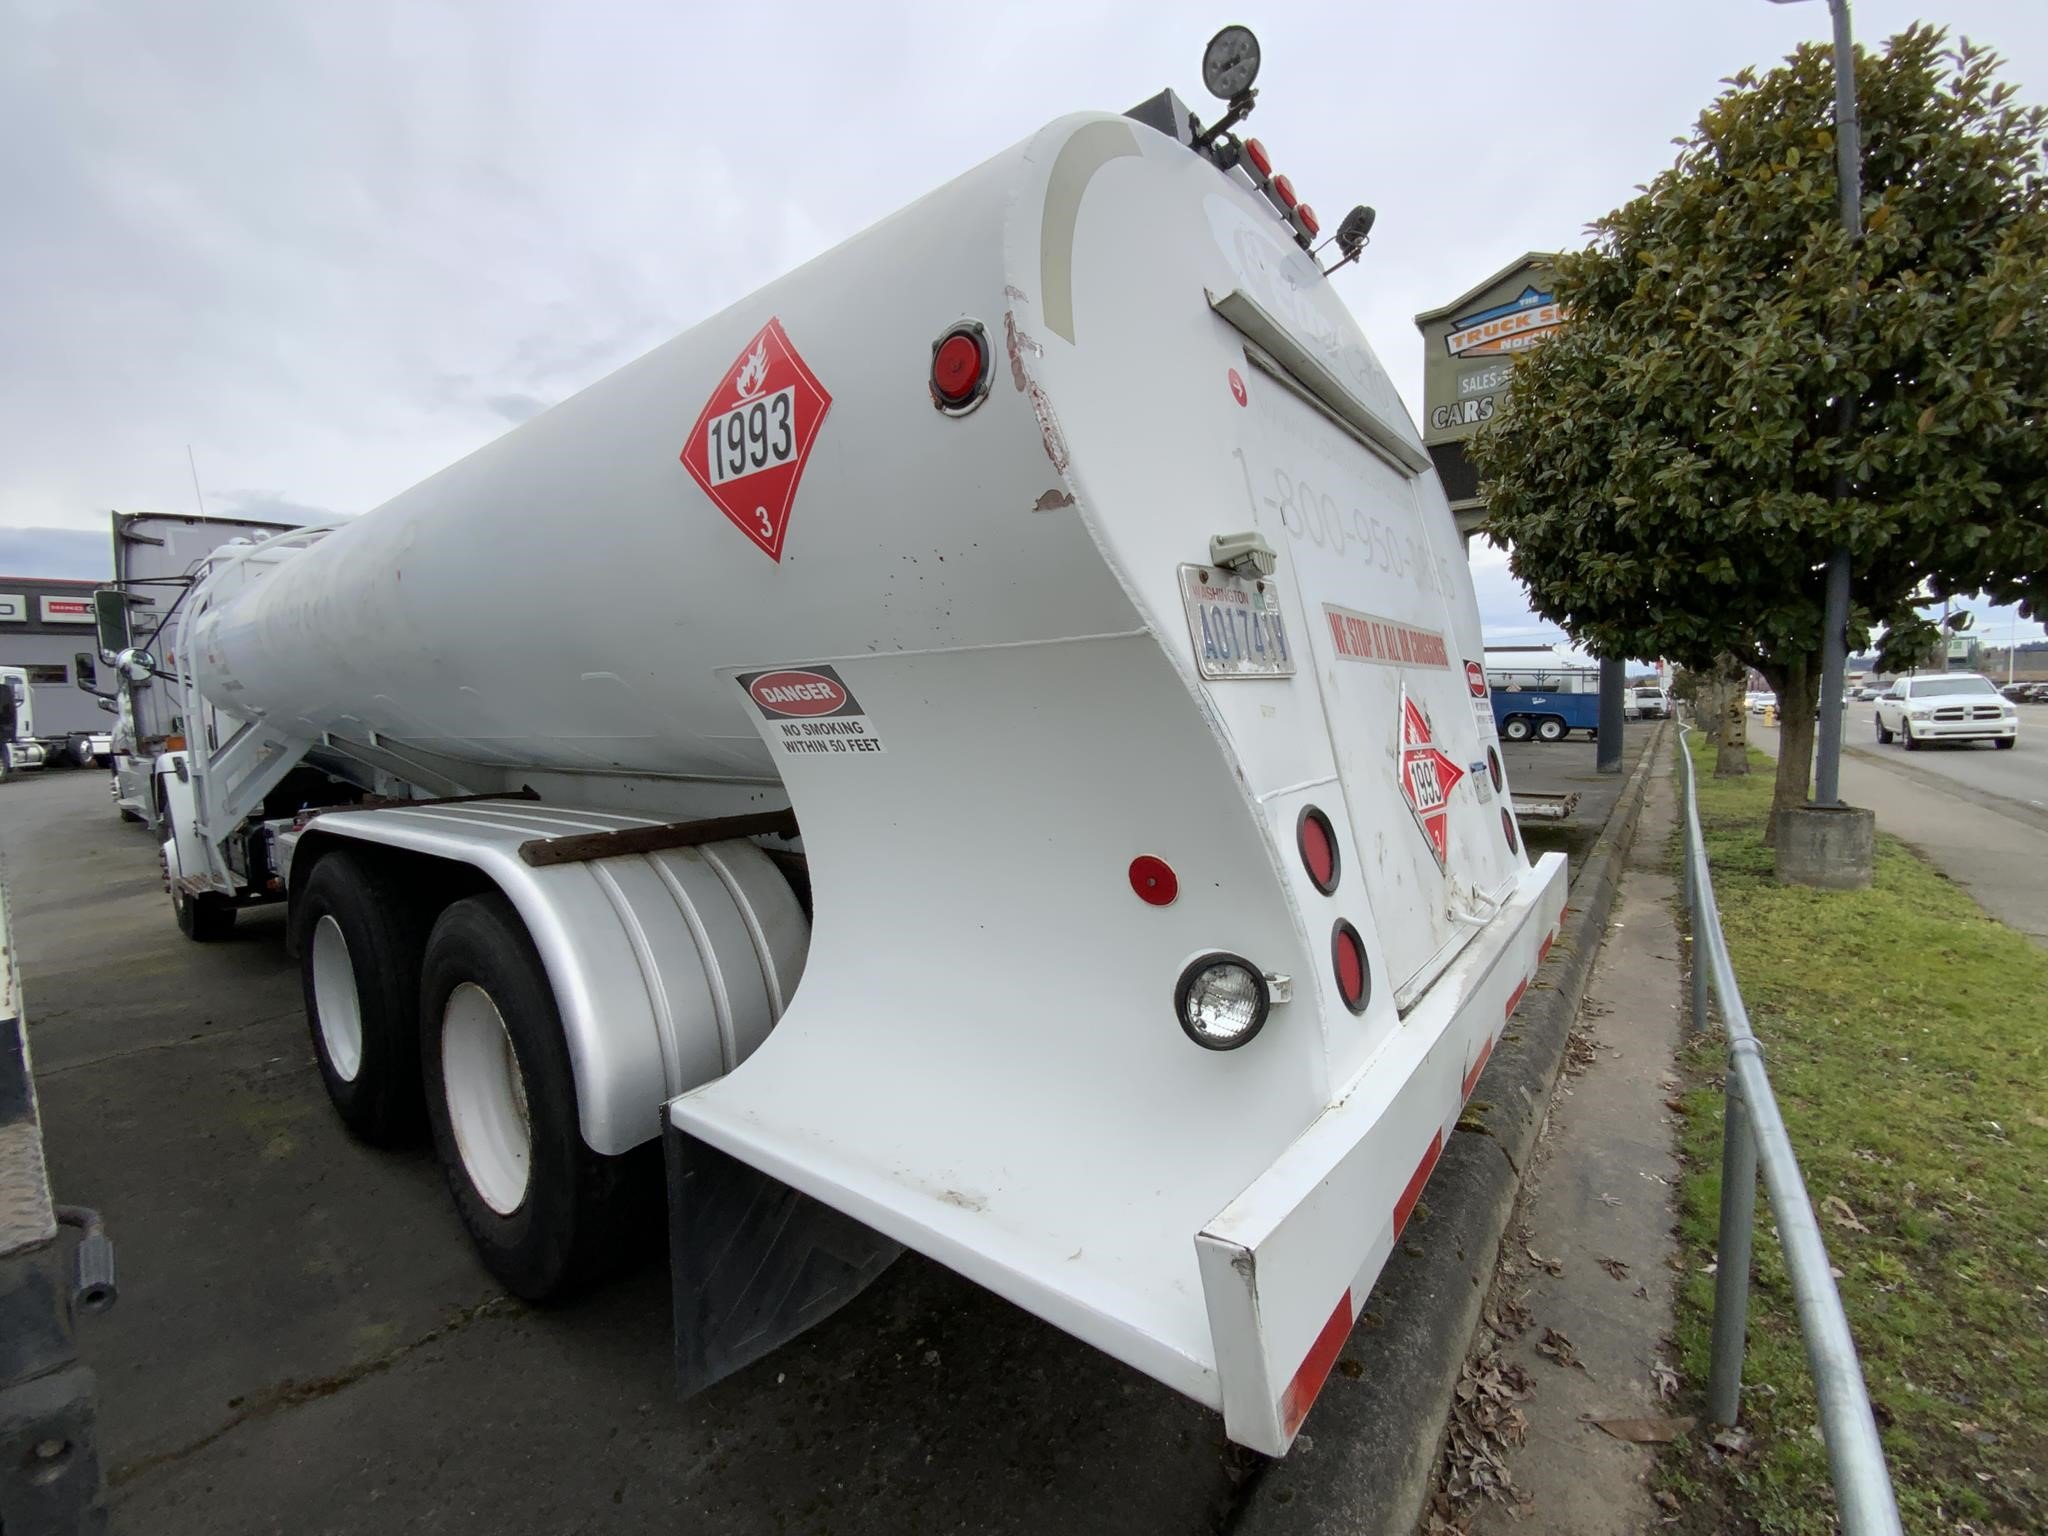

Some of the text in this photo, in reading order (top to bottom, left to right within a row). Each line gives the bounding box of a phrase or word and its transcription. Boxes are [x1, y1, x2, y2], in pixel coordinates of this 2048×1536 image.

[1519, 295, 1540, 307] THE
[1452, 314, 1532, 348] TRUCK
[1431, 396, 1494, 430] CARS
[711, 392, 792, 480] 1993
[756, 506, 774, 538] 3
[1191, 585, 1250, 606] WASHINGTON
[1328, 611, 1351, 655] WE
[1345, 616, 1373, 658] STOP
[1371, 621, 1386, 659] AT
[1383, 624, 1402, 661] ALL
[759, 682, 838, 704] DANGER
[780, 721, 865, 737] NO SMOKING
[782, 738, 882, 753] WITHIN 50 FEET
[1411, 760, 1443, 808] 1993
[1434, 830, 1442, 853] 3
